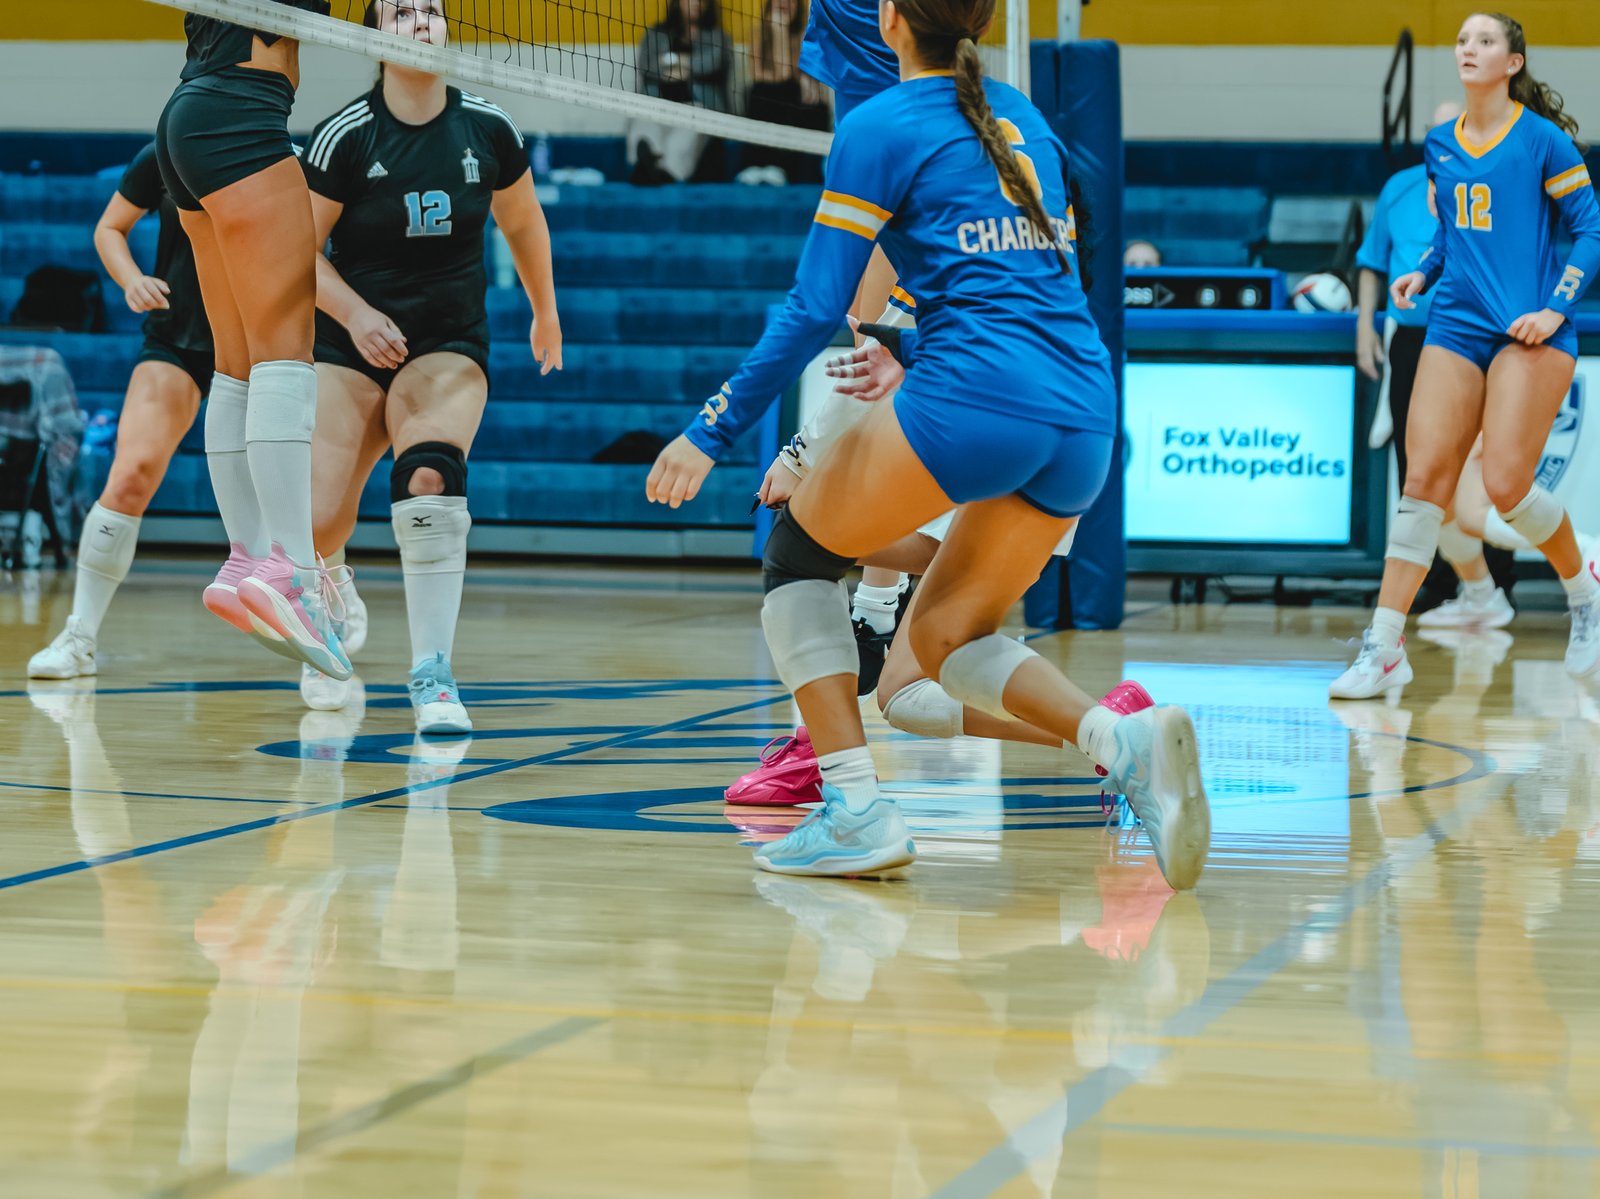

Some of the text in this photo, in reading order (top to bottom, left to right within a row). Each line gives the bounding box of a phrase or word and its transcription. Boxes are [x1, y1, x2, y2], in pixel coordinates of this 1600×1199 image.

[404, 190, 453, 238] 12
[1454, 182, 1492, 232] 12
[1163, 426, 1301, 453] Fox Valley
[1162, 452, 1346, 481] Orthopedics
